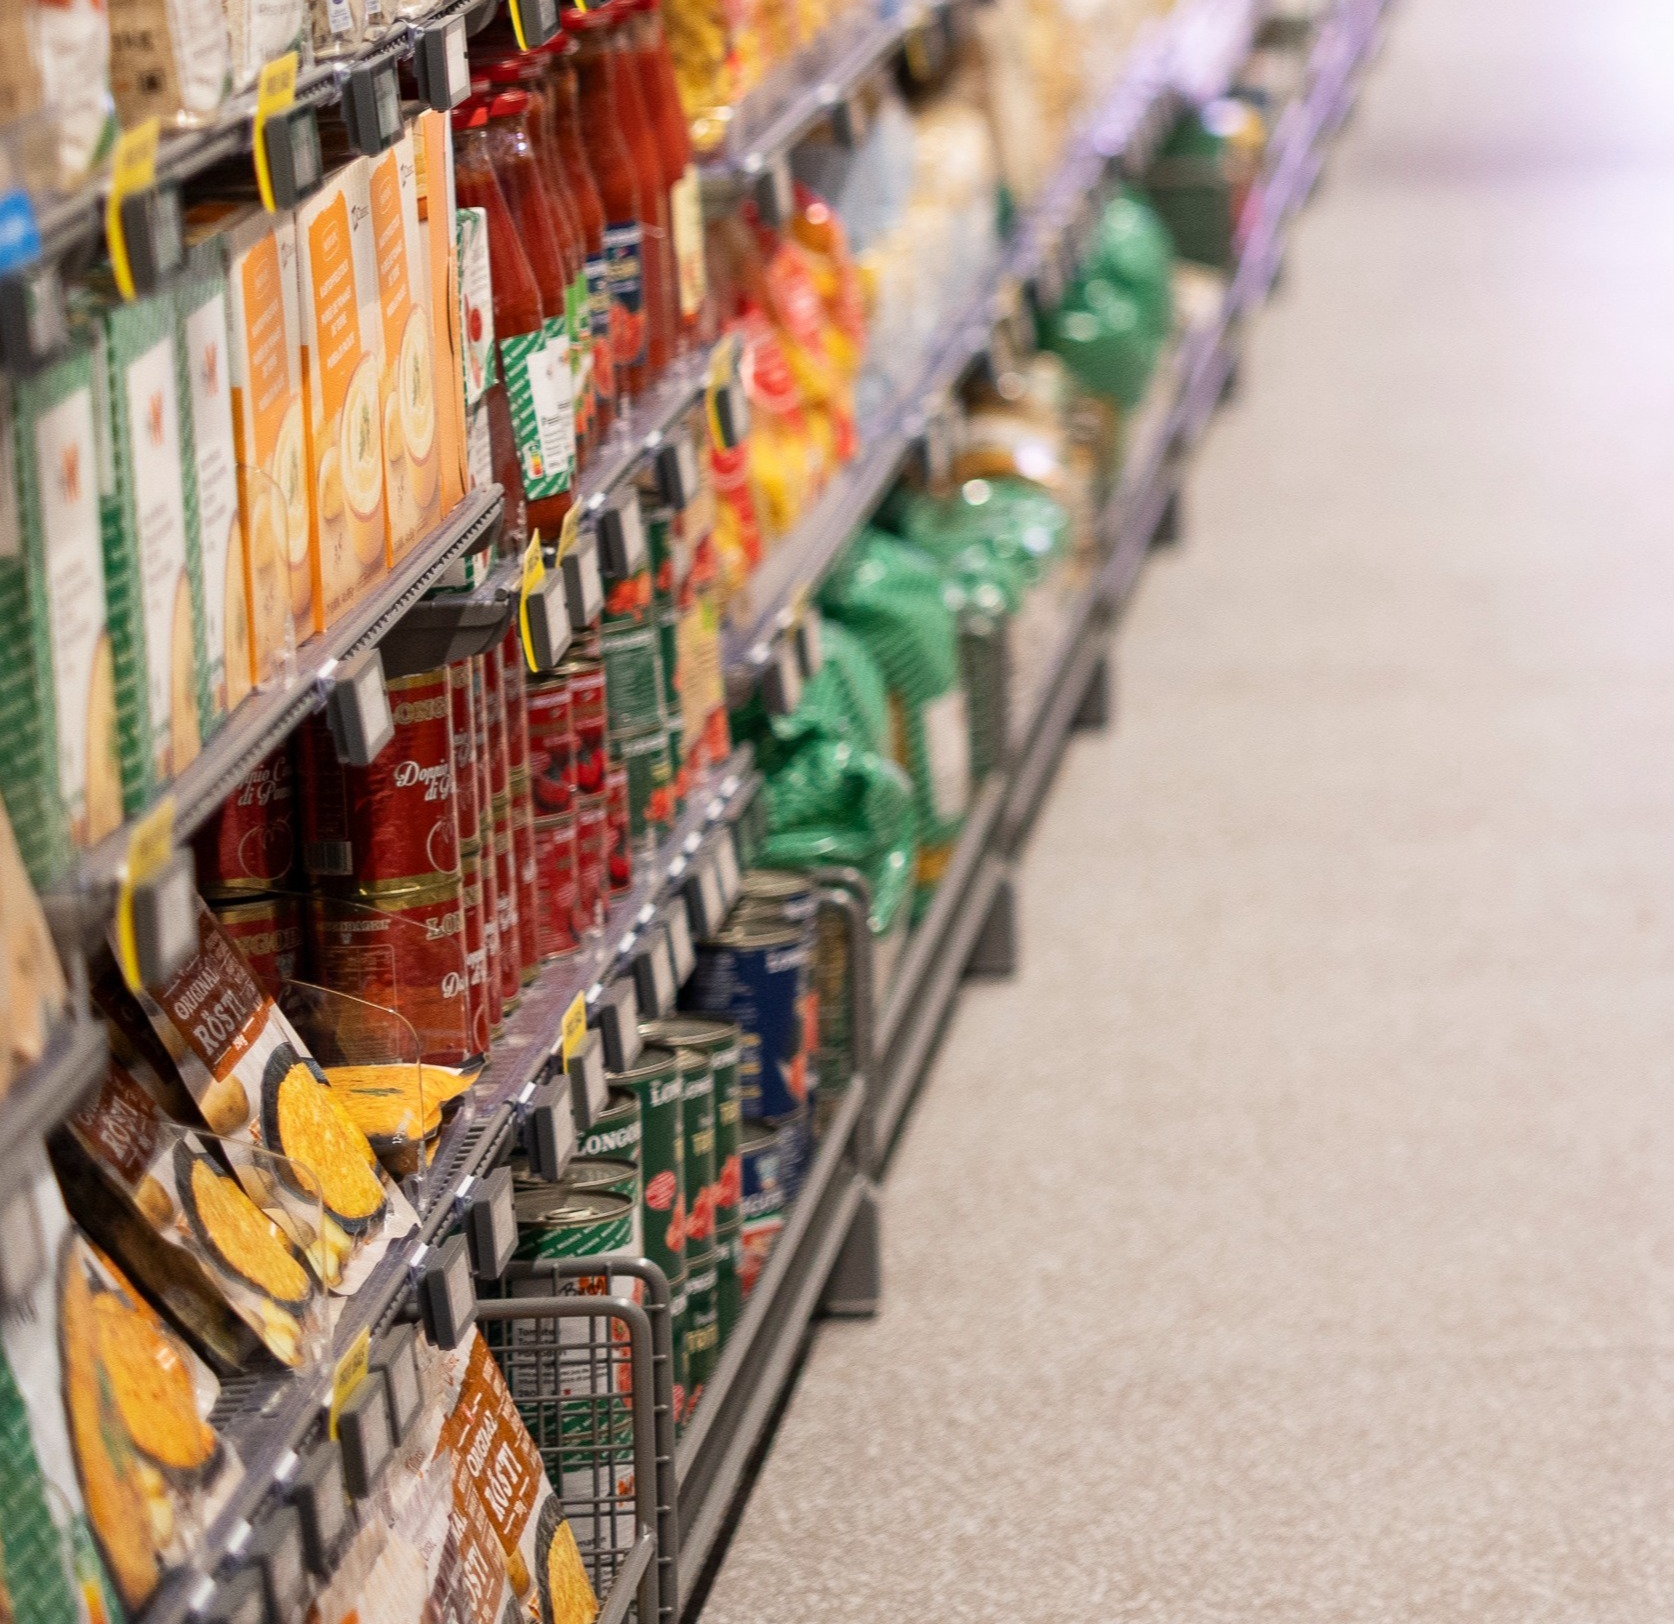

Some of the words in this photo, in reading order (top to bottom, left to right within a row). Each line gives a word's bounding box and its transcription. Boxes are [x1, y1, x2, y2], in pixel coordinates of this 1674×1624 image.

[173, 966, 221, 1020] ORIGINAL
[192, 989, 248, 1056] RÖSTI
[465, 1409, 498, 1477] ORIGINAL
[484, 1440, 523, 1523] RÖSTI
[464, 1537, 490, 1612] ÖSTI
